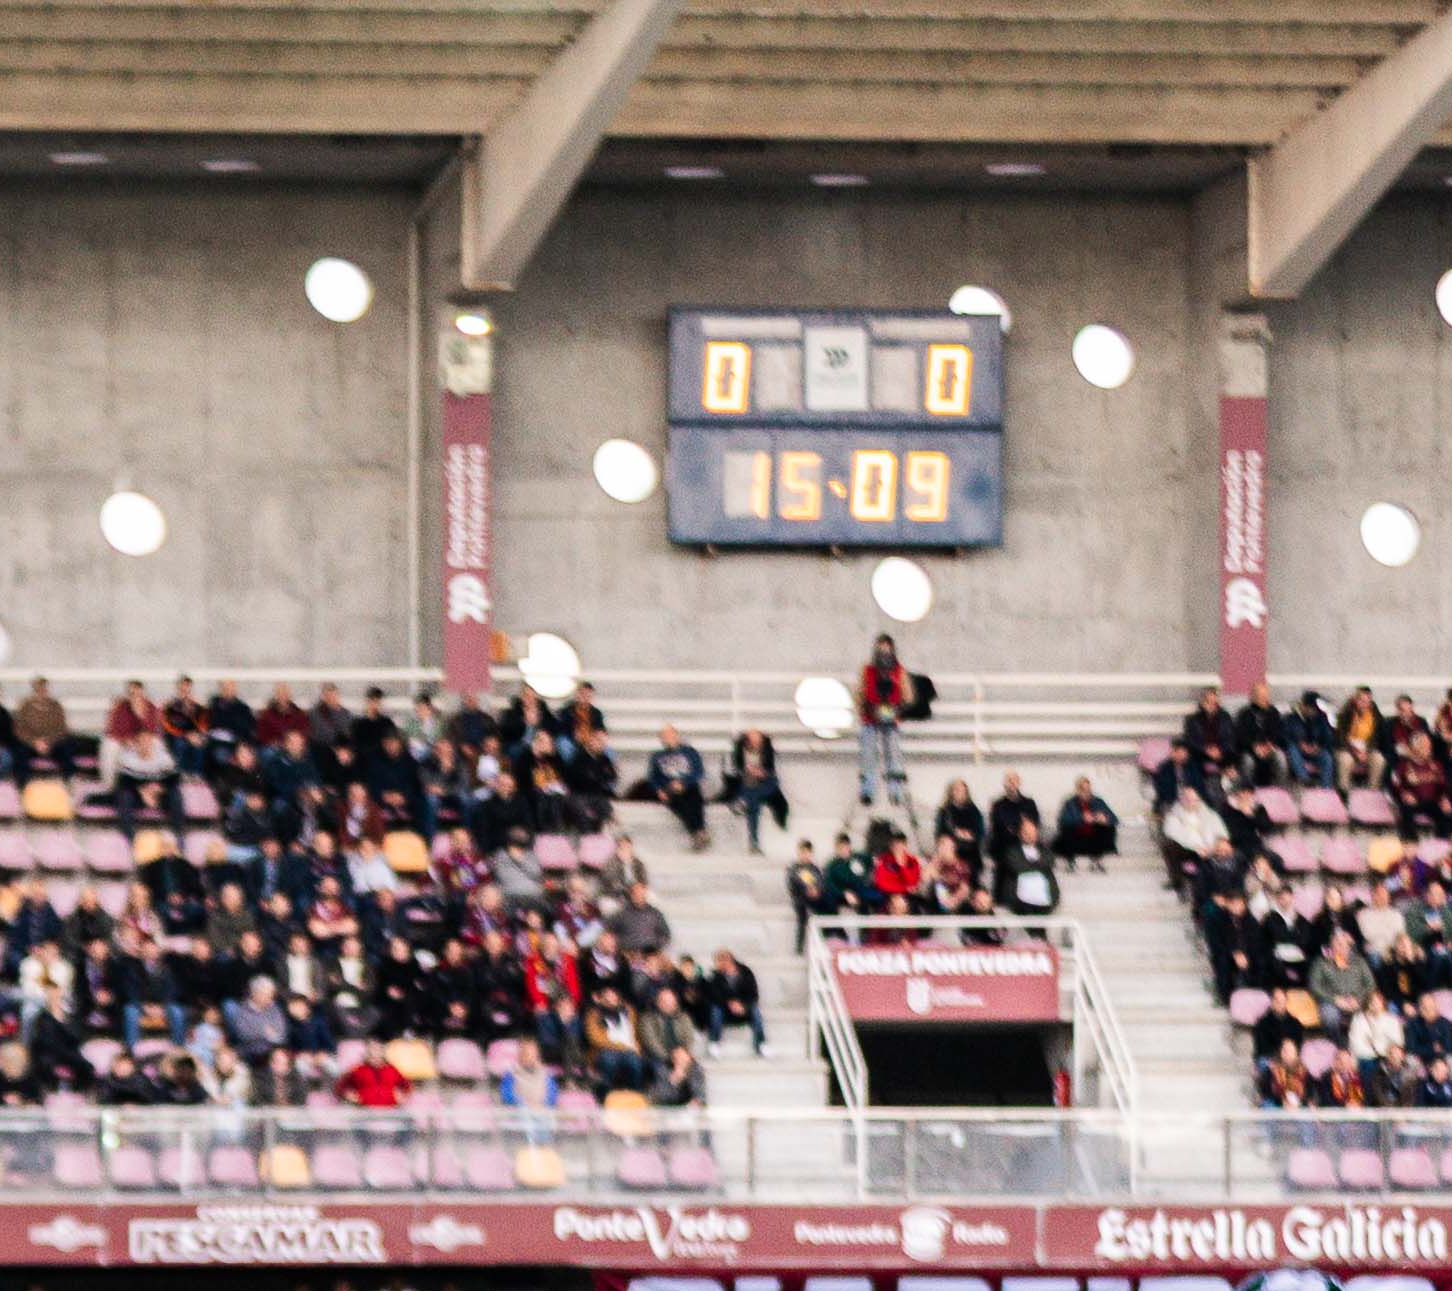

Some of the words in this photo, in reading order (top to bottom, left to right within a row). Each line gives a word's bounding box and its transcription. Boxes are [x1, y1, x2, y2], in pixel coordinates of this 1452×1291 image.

[701, 340, 751, 414] 0
[925, 343, 973, 416] 0
[1096, 1208, 1276, 1262] Estrella
[1282, 1208, 1446, 1262] Galicia
